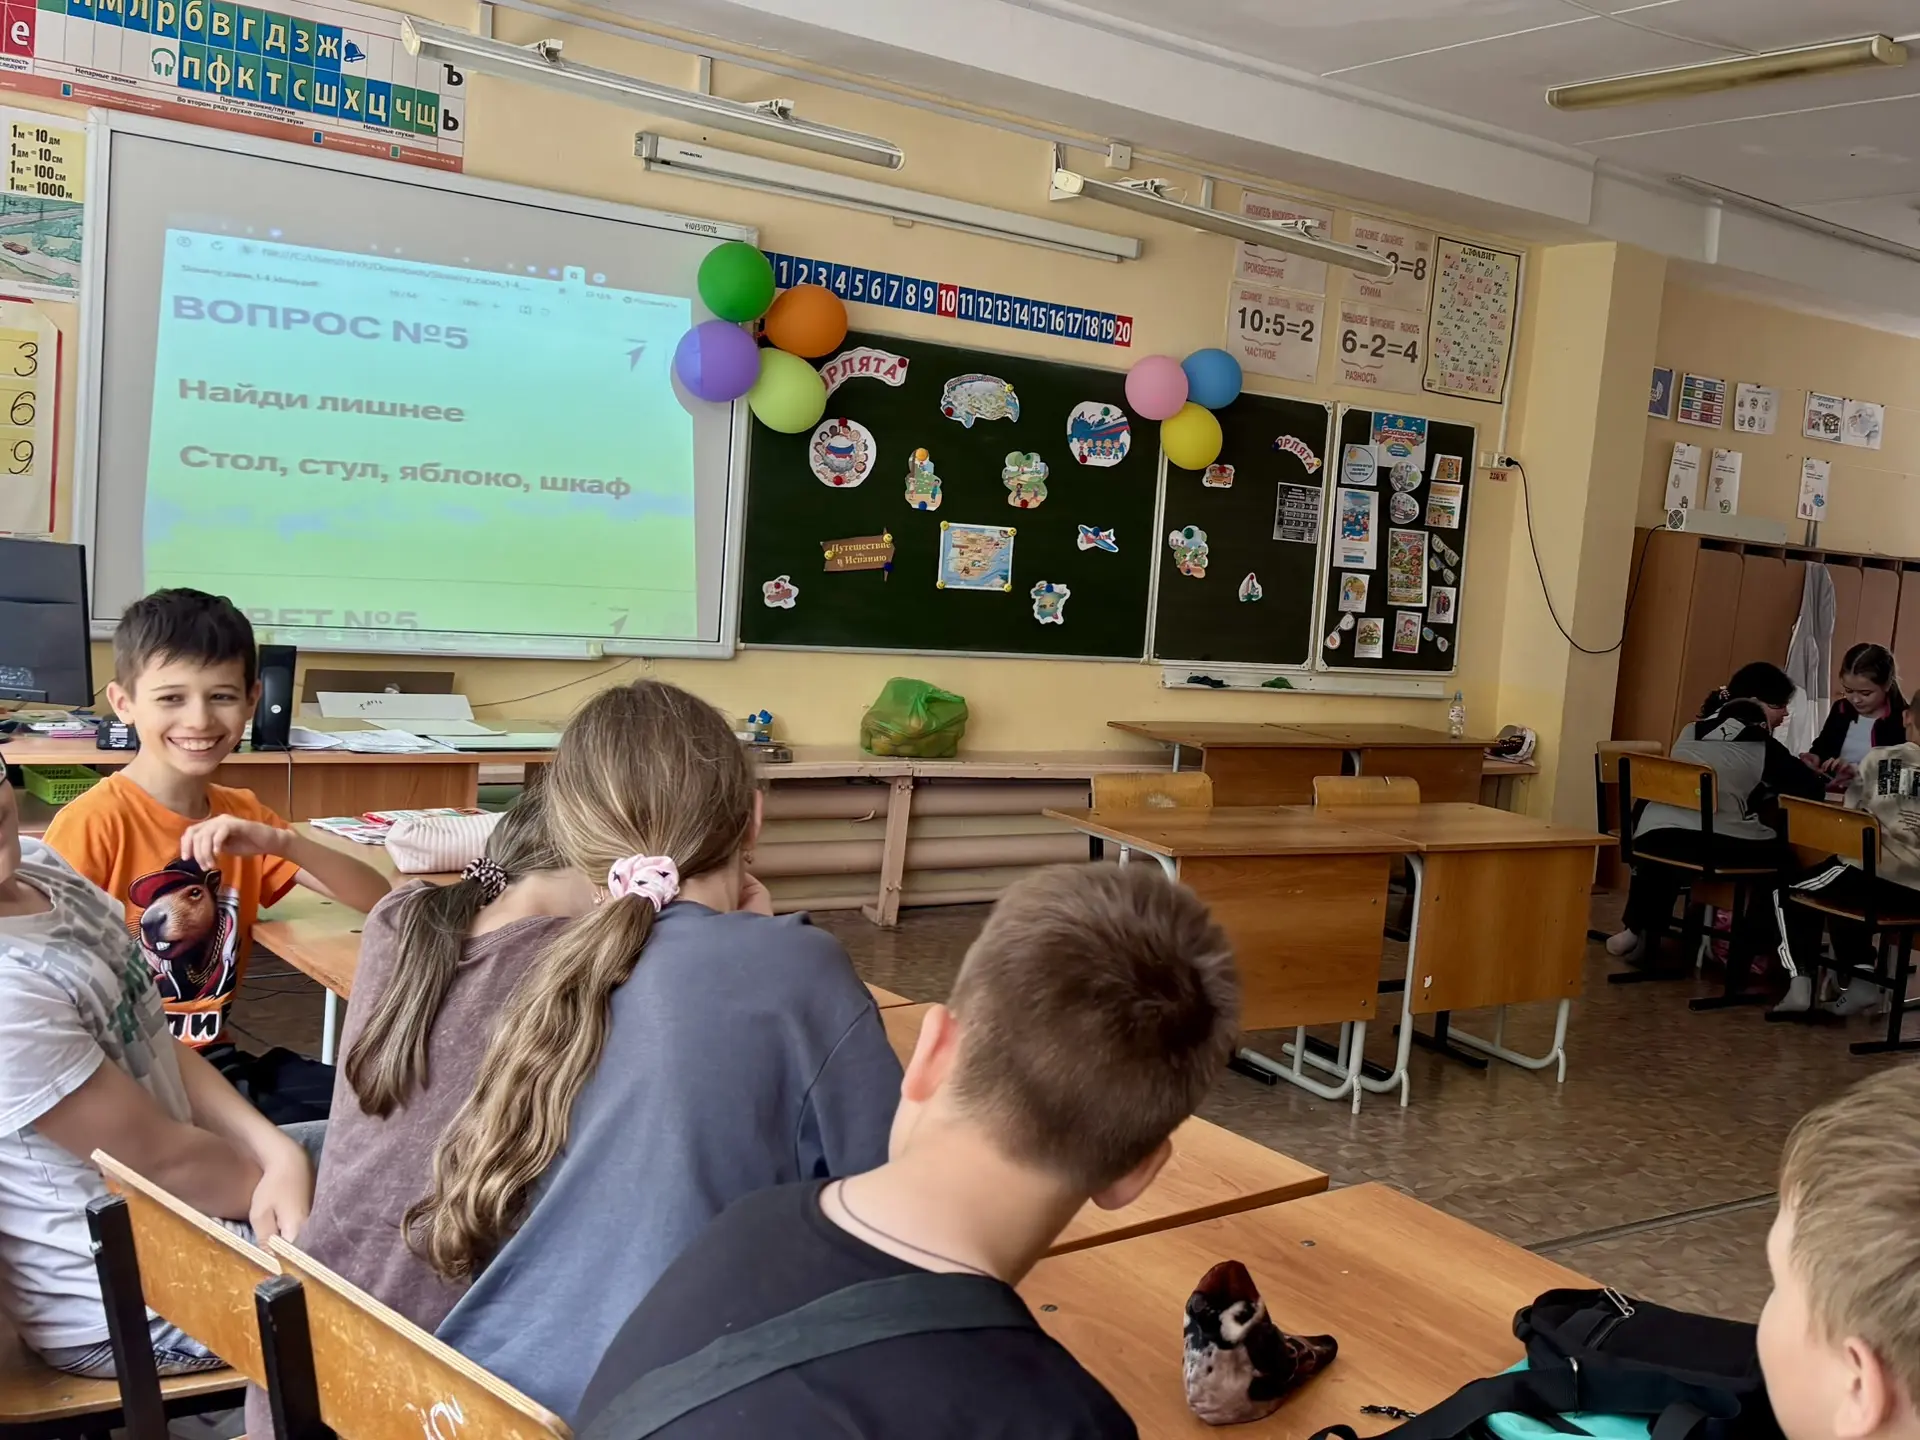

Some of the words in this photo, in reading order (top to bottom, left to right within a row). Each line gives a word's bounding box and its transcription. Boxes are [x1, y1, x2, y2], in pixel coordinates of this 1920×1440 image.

[10, 21, 30, 46] е
[156, 0, 176, 32] р
[185, 0, 203, 31] б
[212, 12, 231, 36] в
[242, 18, 256, 41] г
[265, 23, 286, 54] д
[294, 29, 310, 53] з
[316, 34, 340, 60] ж
[75, 67, 110, 80] Непарные
[110, 75, 137, 86] звонкие
[182, 55, 201, 81] п
[207, 54, 231, 93] ф
[237, 66, 255, 91] к
[266, 71, 282, 95] т
[293, 78, 307, 102] с
[314, 82, 337, 107] ш
[343, 87, 361, 112] х
[368, 92, 387, 123] ц
[395, 98, 411, 122] ч
[416, 102, 436, 133] щ
[187, 97, 212, 109] втором
[212, 103, 229, 113] ряду
[229, 105, 252, 118] глухие
[253, 109, 285, 123] согласные
[286, 116, 304, 126] звуки
[219, 96, 245, 107] Парные
[1460, 247, 1497, 261] АЛФАВИТ
[779, 260, 788, 284] 1
[796, 263, 809, 285] 2
[817, 267, 827, 288] 3
[834, 271, 847, 294] 4
[852, 273, 865, 297] 5
[870, 277, 882, 300] 6
[888, 279, 900, 303] 7
[905, 283, 916, 306] 8
[923, 286, 934, 309] 9
[939, 289, 956, 313] 10
[959, 293, 974, 316] 11
[977, 296, 993, 320] 12
[995, 299, 1011, 323] 13
[1013, 302, 1029, 326] 14
[1031, 306, 1047, 328] 15
[1049, 309, 1064, 332] 16
[1066, 312, 1082, 335] 17
[1084, 315, 1099, 337] 18
[1100, 318, 1114, 340] 19
[1115, 320, 1131, 343] 20
[1360, 285, 1382, 298] СУММА
[172, 294, 382, 340] ВОПРОС
[392, 319, 469, 350] №5
[1237, 306, 1315, 343] 10:5=2
[13, 341, 39, 377] 3
[1244, 345, 1277, 361] ЧАСТНОЕ
[1341, 329, 1419, 364] 6-2=4
[1344, 369, 1378, 384] РАЗНОСТЬ
[10, 390, 36, 426] 6
[178, 377, 309, 410] Найди
[316, 394, 466, 423] лишнее
[8, 439, 34, 475] 9
[179, 444, 289, 477] Стол,
[298, 457, 389, 484] стул,
[398, 461, 531, 494] яблоко,
[539, 475, 632, 500] шкаф
[831, 542, 892, 554] Путешествие
[845, 555, 887, 565] Испанию
